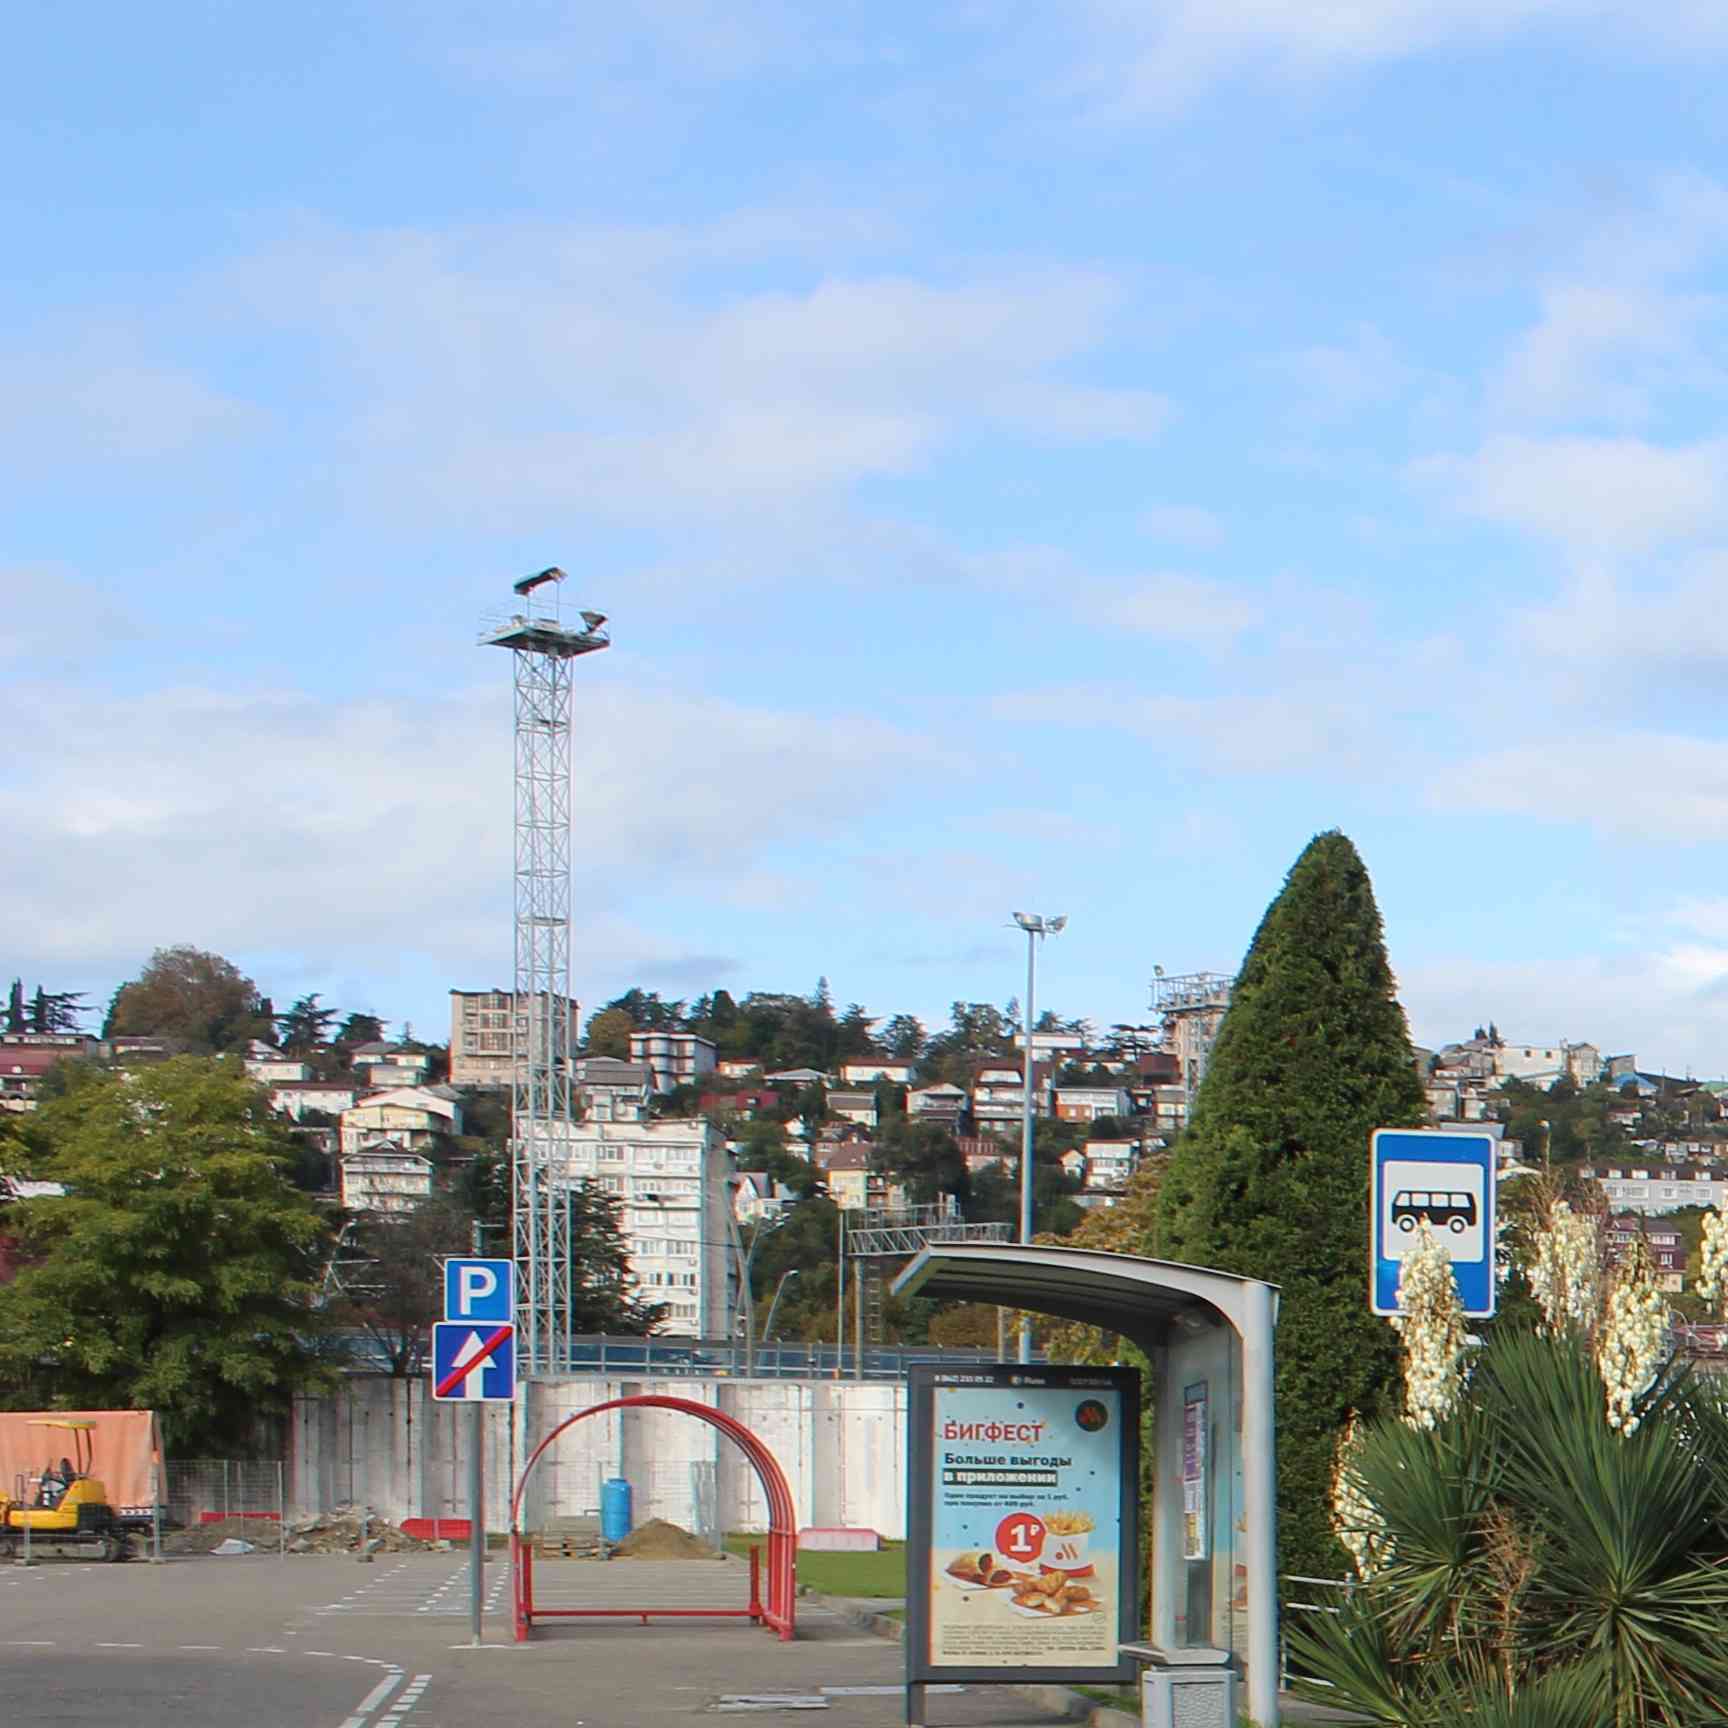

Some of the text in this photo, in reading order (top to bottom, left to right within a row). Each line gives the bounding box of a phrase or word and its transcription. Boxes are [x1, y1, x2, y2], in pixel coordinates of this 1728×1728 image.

[460, 1266, 497, 1316] P
[944, 1421, 1043, 1442] БИГФЕСТ
[945, 1453, 1072, 1468] Больше выгоды
[944, 1471, 1057, 1485] в приложении
